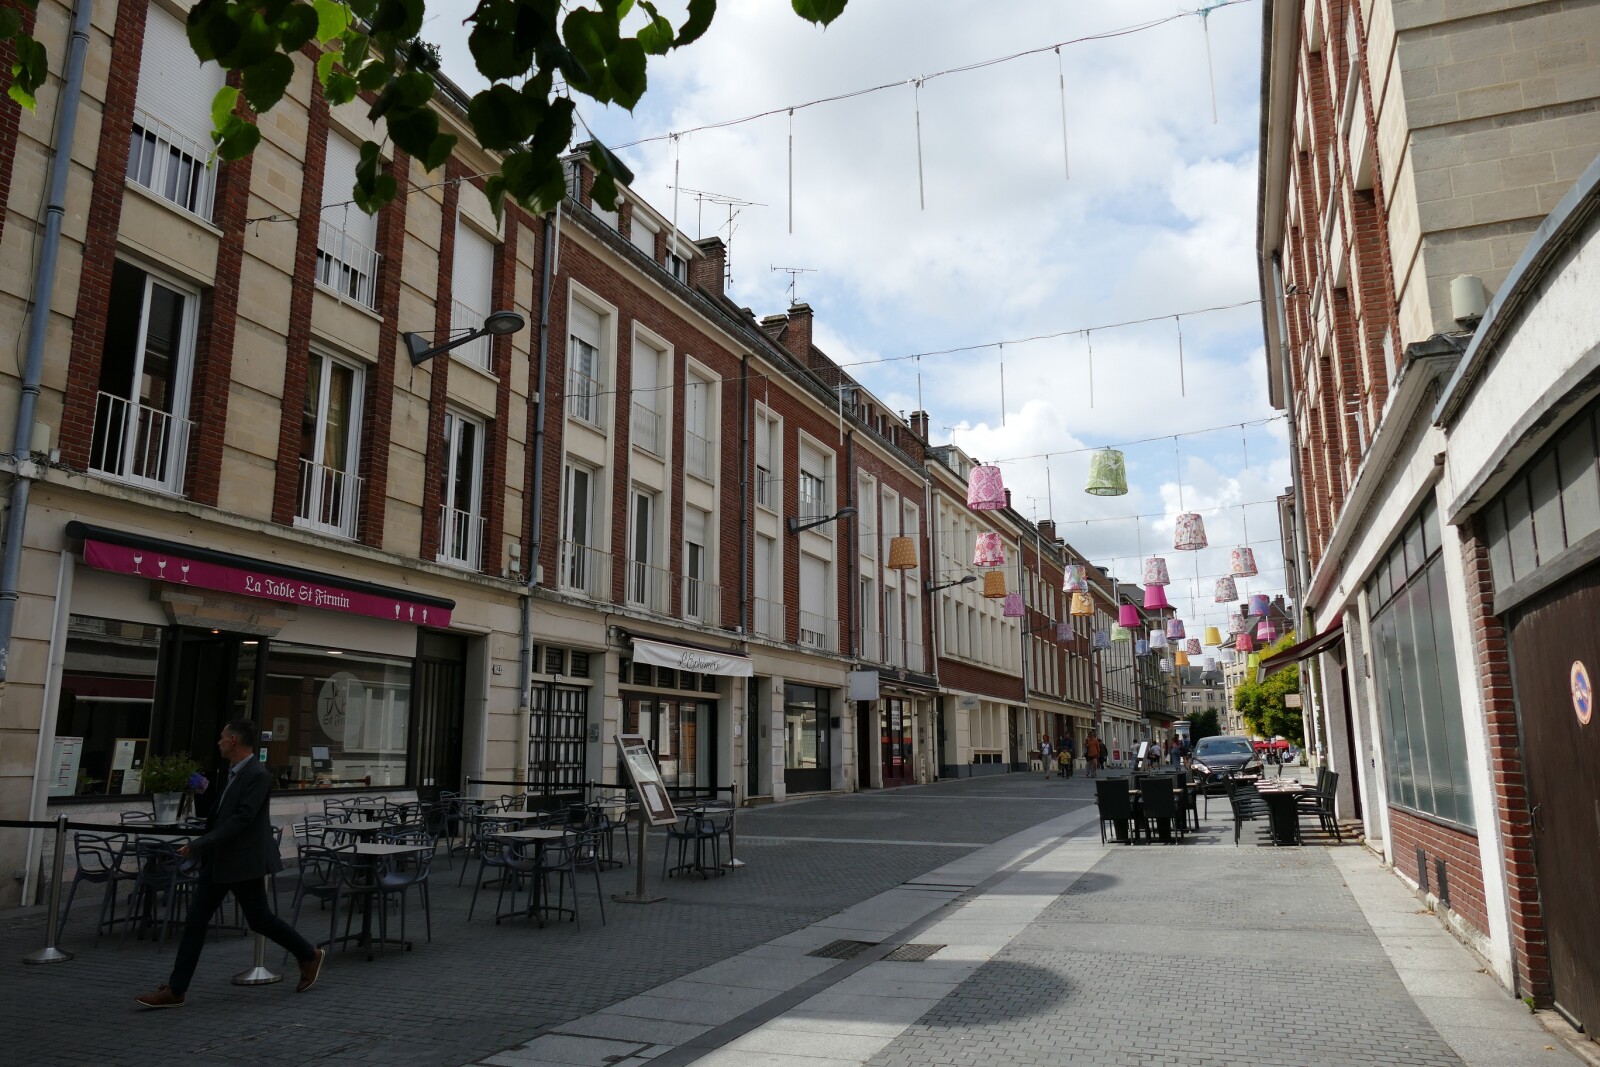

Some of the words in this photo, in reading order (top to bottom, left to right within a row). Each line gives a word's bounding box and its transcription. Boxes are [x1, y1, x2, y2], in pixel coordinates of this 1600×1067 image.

[245, 576, 261, 593] La
[264, 579, 295, 599] Table
[298, 585, 313, 602] St
[315, 588, 350, 608] Firmin
